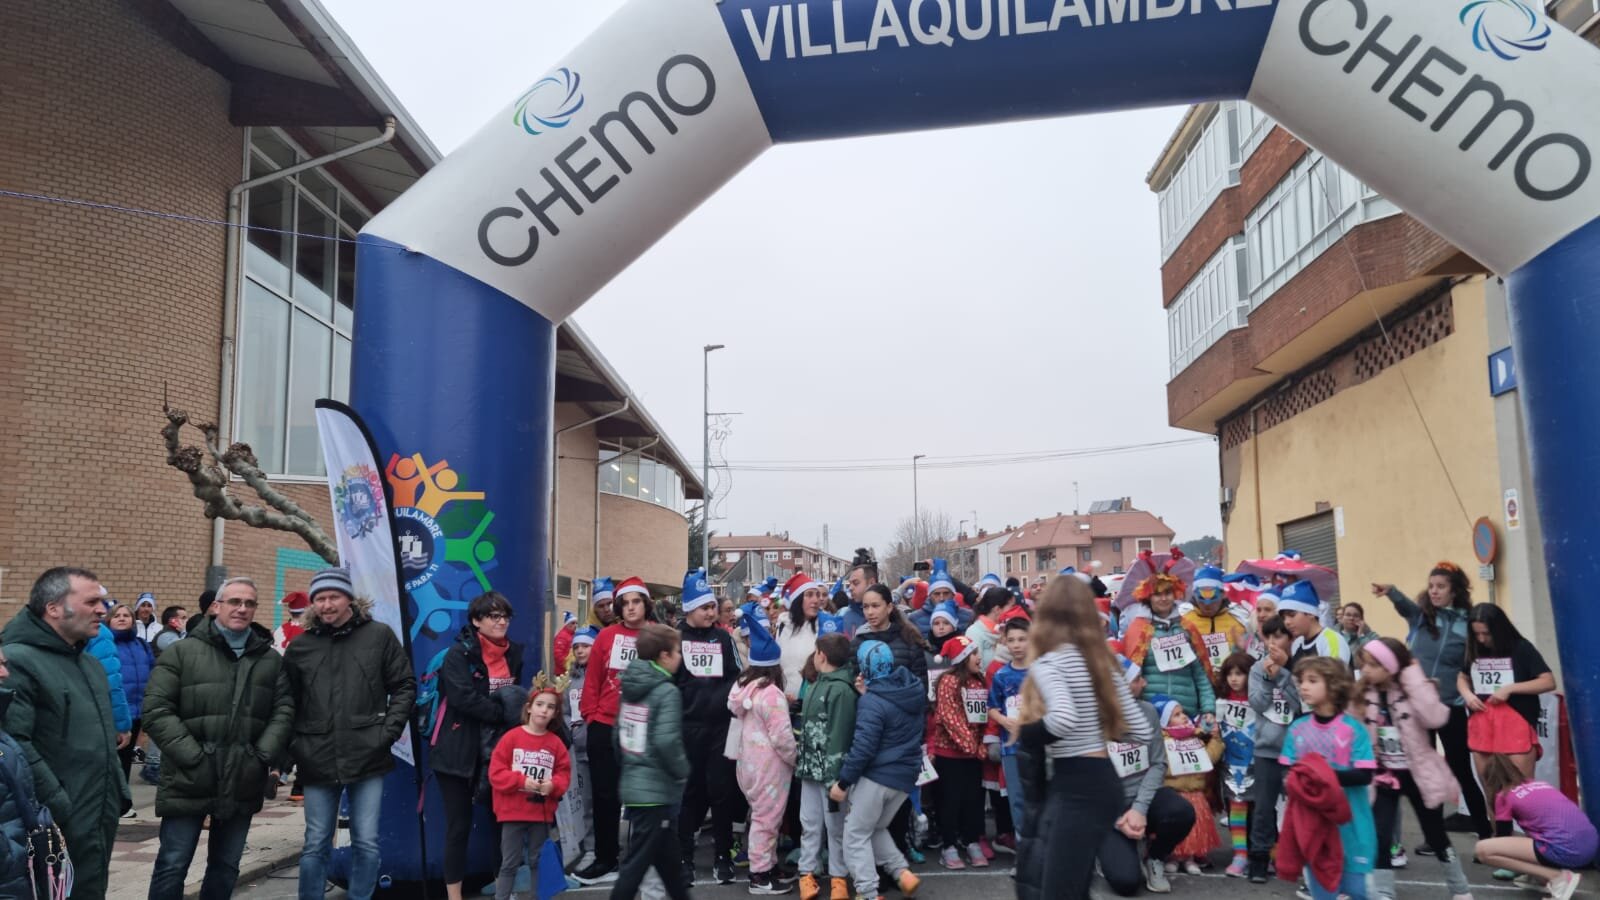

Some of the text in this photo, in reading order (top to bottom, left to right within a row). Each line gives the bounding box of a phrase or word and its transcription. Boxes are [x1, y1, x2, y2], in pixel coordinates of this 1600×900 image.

[741, 0, 1273, 61] VILLAQUILA
[395, 507, 444, 539] UILAMBRE
[412, 572, 433, 590] PARA
[429, 563, 440, 572] TI
[620, 648, 637, 661] 50
[1164, 646, 1184, 662] 712
[1206, 645, 1220, 658] 13
[691, 654, 714, 667] 587
[1479, 671, 1502, 685] 732
[966, 701, 987, 714] 508
[1227, 703, 1247, 720] 714
[1120, 749, 1142, 767] 782
[1179, 751, 1199, 765] 715
[522, 765, 545, 780] 794
